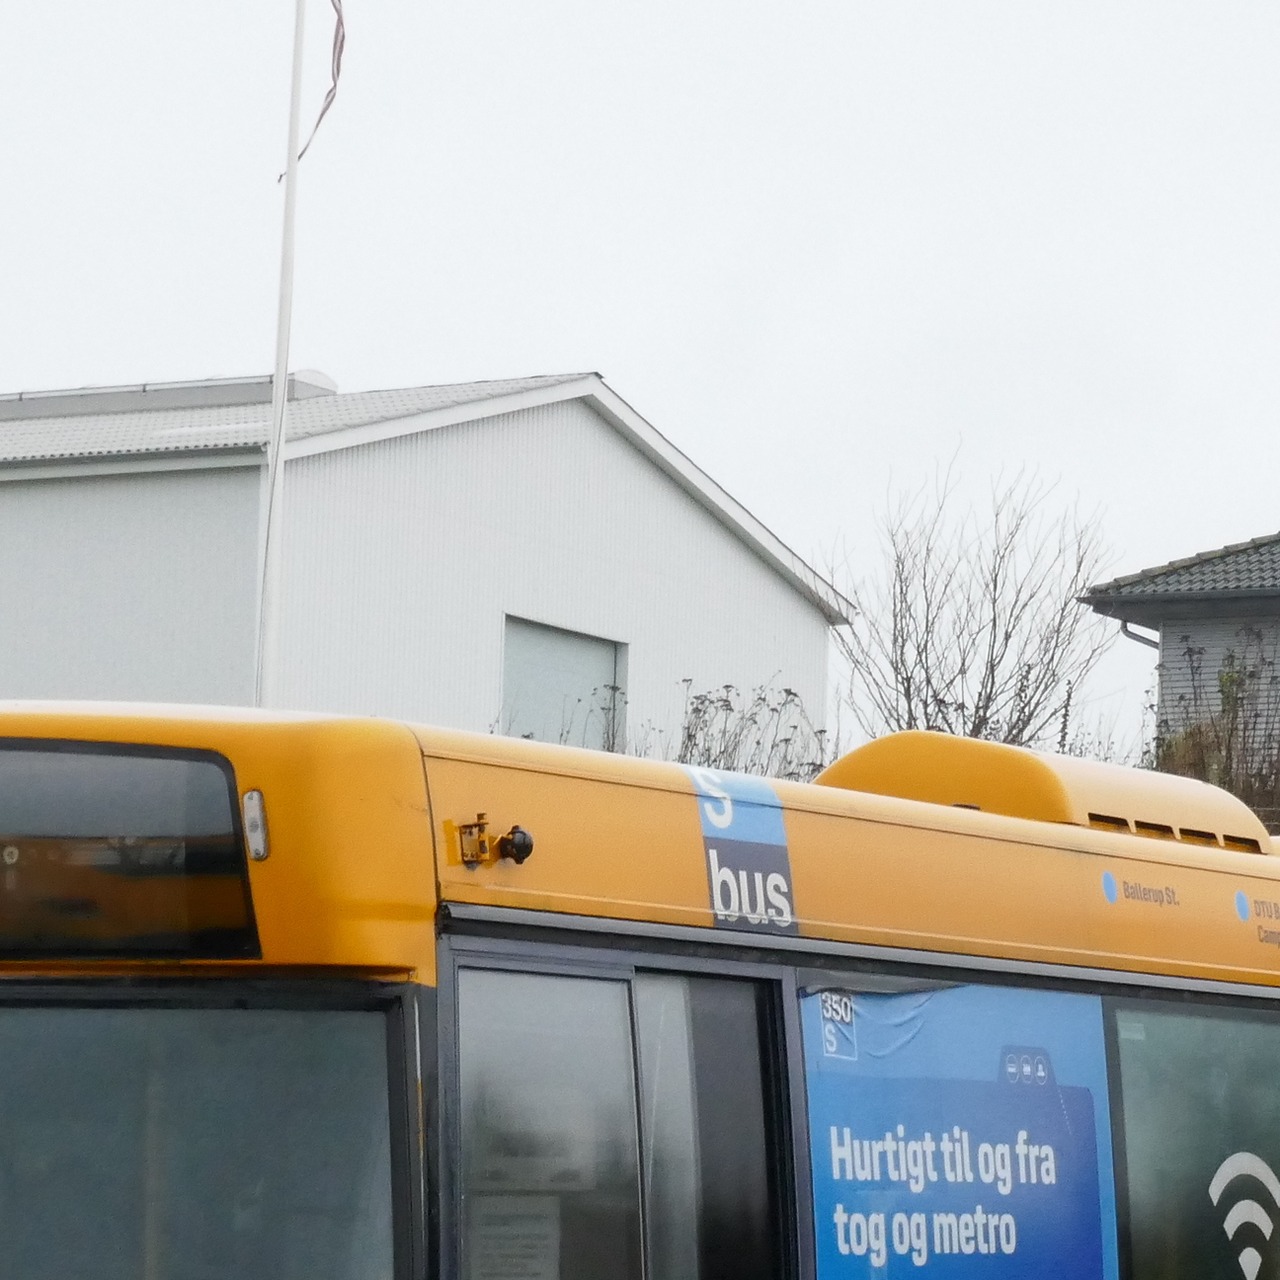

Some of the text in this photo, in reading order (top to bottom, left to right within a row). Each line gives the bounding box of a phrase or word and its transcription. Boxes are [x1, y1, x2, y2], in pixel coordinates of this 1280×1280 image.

[708, 849, 792, 928] bus
[1122, 881, 1180, 907] Ballerup St.
[821, 991, 851, 1023] 350
[825, 1023, 837, 1053] S
[830, 1124, 1057, 1195] Hurtigt til og fra
[834, 1203, 1018, 1267] tog og metro
